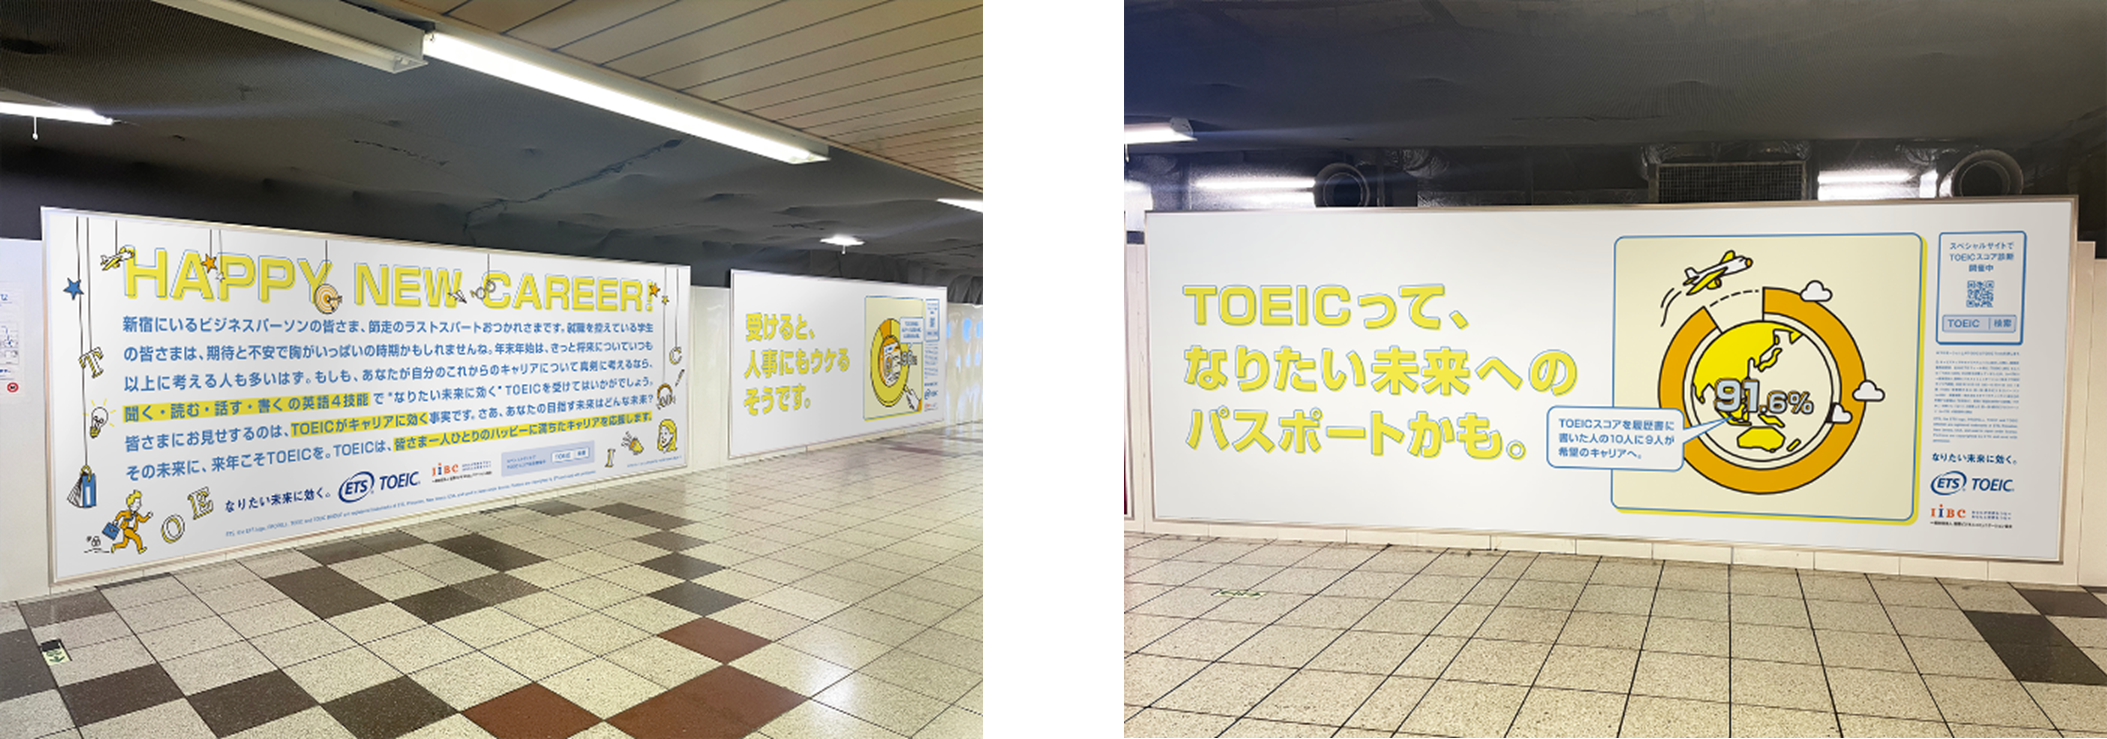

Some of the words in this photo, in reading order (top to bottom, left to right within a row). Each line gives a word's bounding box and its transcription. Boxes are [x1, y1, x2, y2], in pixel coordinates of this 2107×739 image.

[124, 245, 334, 304] HAPPY
[354, 262, 463, 308] NEW
[481, 270, 654, 312] CAREER!
[1183, 284, 1469, 331] TOEICって、
[745, 312, 815, 342] 受けると、
[1947, 318, 1980, 328] TOEIC
[744, 347, 850, 379] 人事にもウケる
[1184, 345, 1578, 397] なりたい未来への
[743, 384, 811, 416] そうです。
[1714, 378, 1814, 415] 91.6%
[1186, 407, 1528, 461] パスポートかも。
[1558, 418, 1675, 431] TOEICスコアを履歴書に
[1558, 433, 1675, 446] 書いた人の10人に9人が
[1558, 446, 1642, 459] 希望のキャリアへ。
[1932, 452, 2017, 465] なりたい未来に効く。
[345, 479, 368, 495] ETS
[380, 471, 419, 490] TOEIC
[1937, 478, 1961, 489] ETS
[1972, 478, 2013, 492] TOEIC
[225, 487, 331, 513] なりたい未来に効く。
